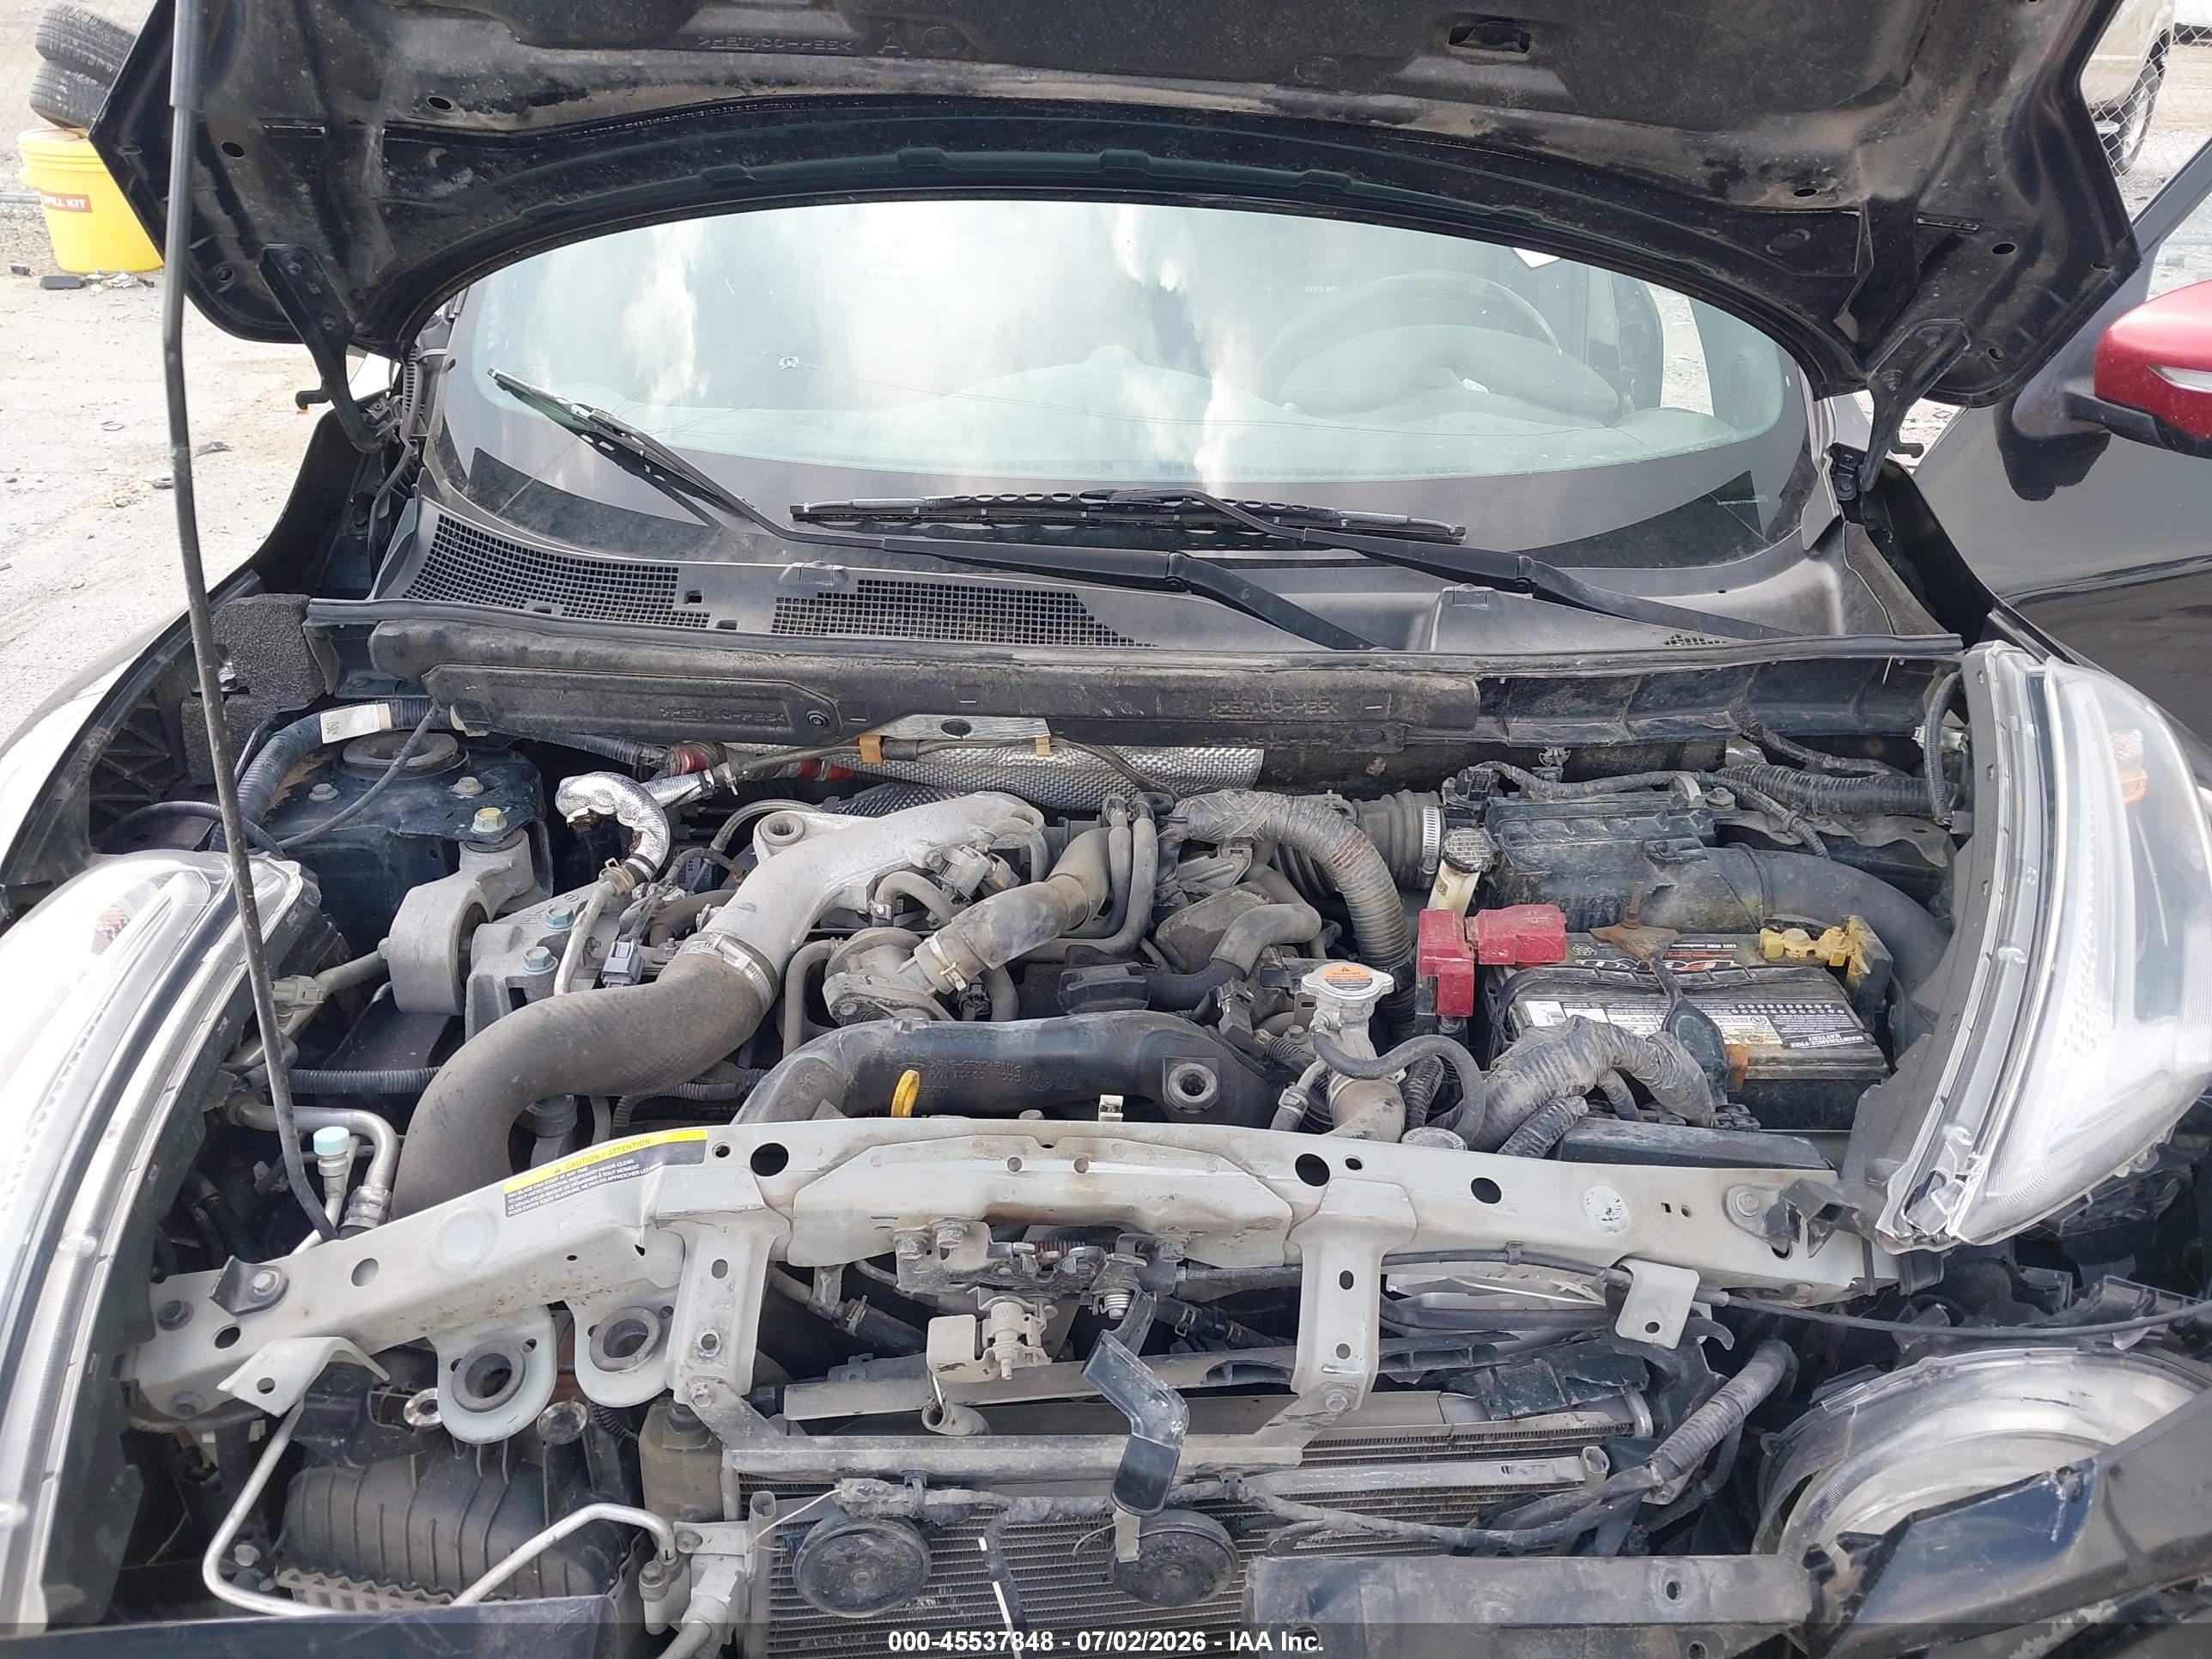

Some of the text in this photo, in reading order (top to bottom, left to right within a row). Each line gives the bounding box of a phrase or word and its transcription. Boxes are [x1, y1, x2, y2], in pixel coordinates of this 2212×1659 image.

[66, 198, 86, 209] KIT
[566, 1155, 599, 1169] CAUTION
[607, 1139, 651, 1155] ATTENTION
